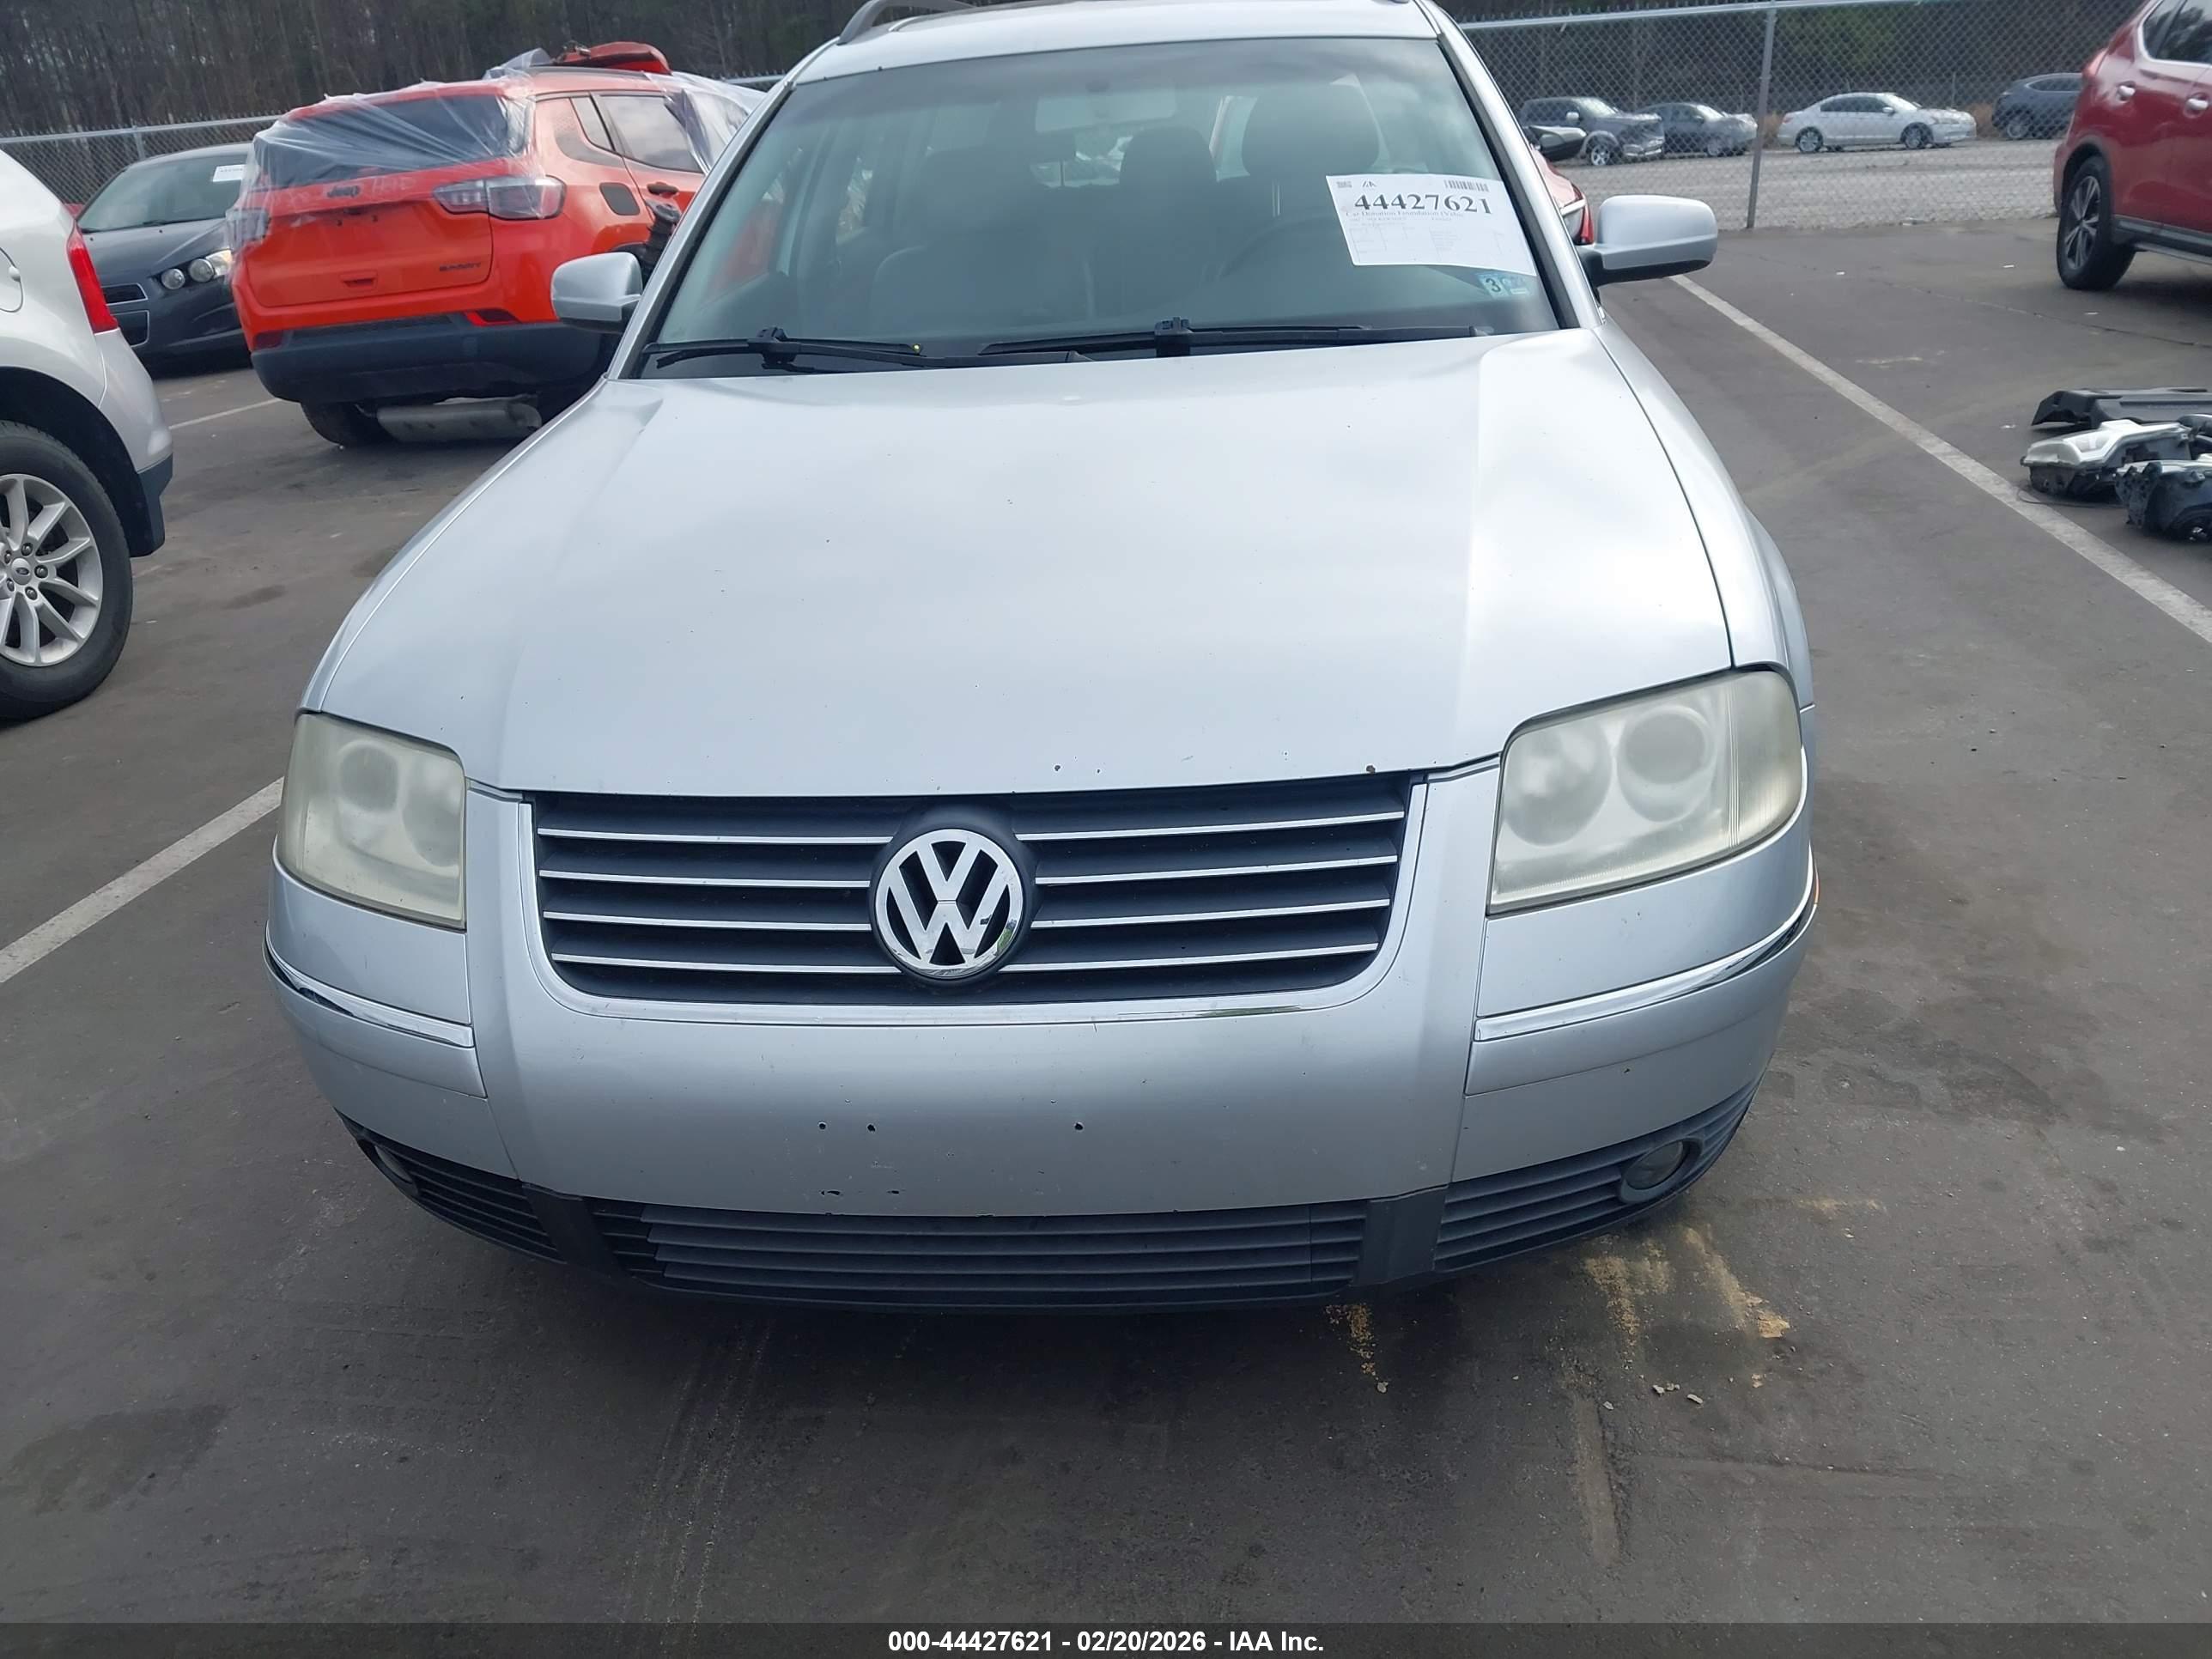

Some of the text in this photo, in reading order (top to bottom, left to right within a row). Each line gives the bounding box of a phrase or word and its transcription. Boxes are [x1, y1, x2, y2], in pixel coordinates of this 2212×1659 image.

[1354, 193, 1492, 215] 44427621
[1486, 278, 1502, 293] 3
[874, 830, 1023, 977] VW
